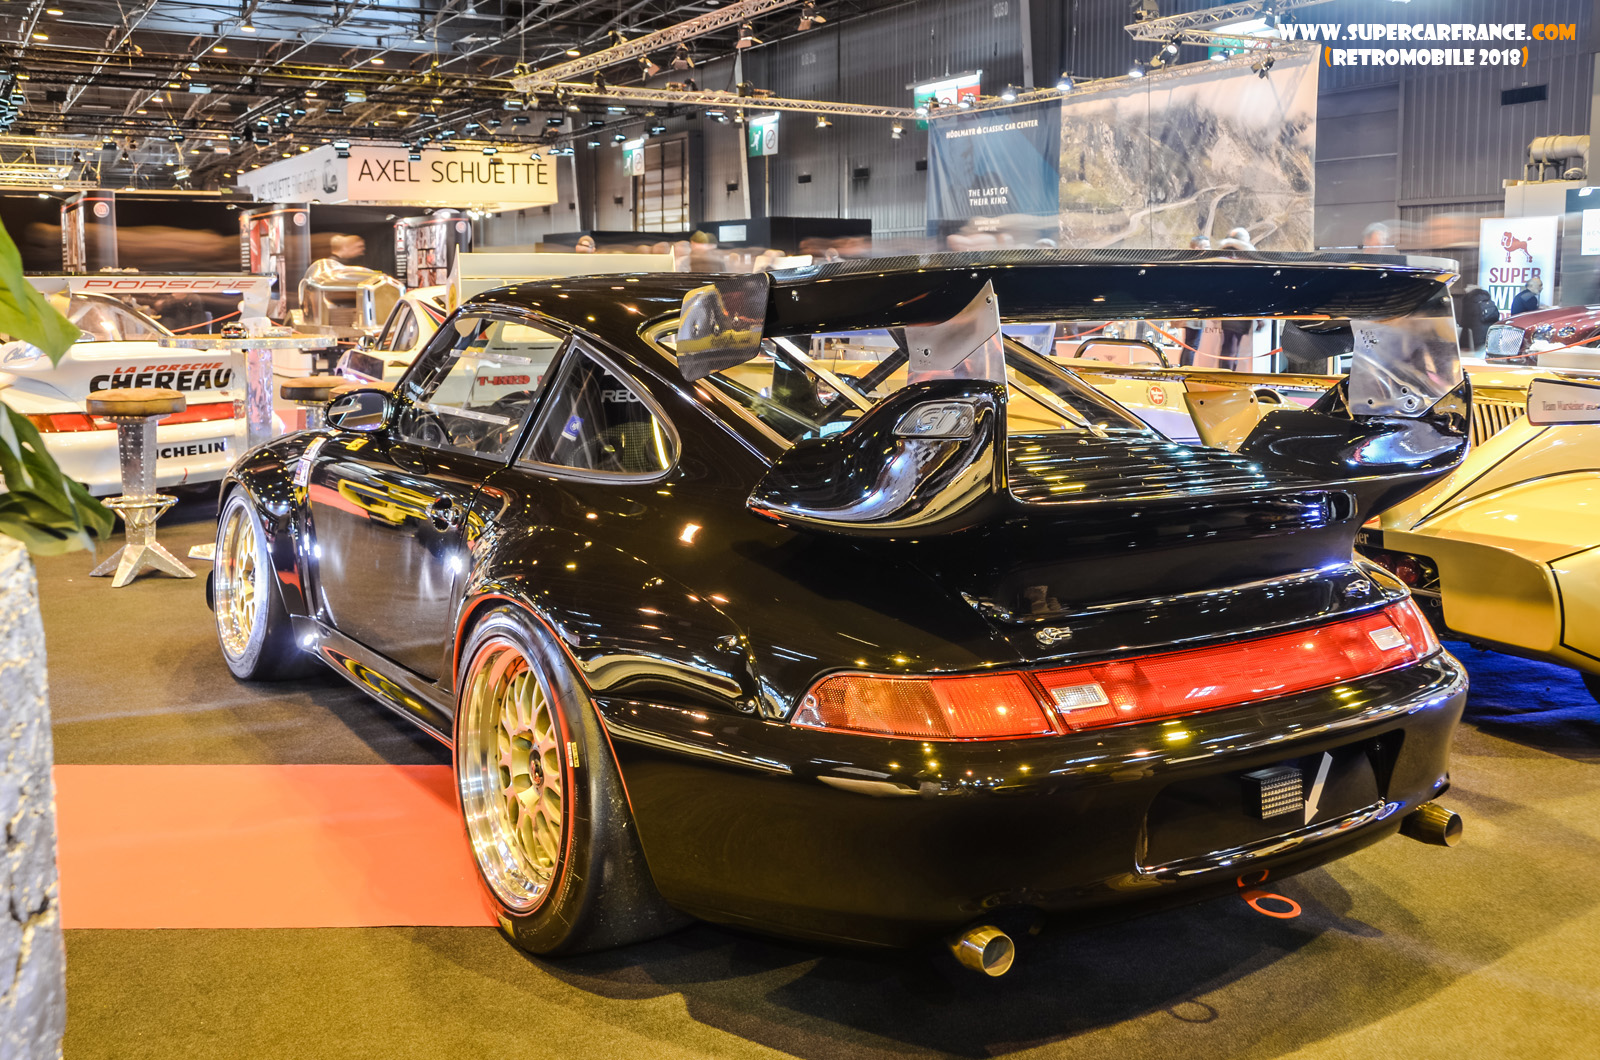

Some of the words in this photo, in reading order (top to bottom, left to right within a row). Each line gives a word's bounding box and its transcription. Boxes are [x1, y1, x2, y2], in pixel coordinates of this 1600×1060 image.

[982, 124, 1004, 134] CLASSIC
[1005, 122, 1016, 131] CAR
[1016, 119, 1039, 129] CENTER
[358, 158, 420, 182] AXEL
[431, 160, 548, 185] SCHUETTE
[968, 189, 981, 197] THE
[983, 187, 998, 196] LAST
[999, 186, 1009, 195] OF
[969, 198, 988, 206] THEIR
[990, 196, 1008, 205] KIND.
[1489, 267, 1541, 283] SUPER
[84, 280, 257, 289] PORSCHE
[113, 366, 137, 374] LA
[142, 362, 223, 373] PORSCHE
[156, 441, 226, 460] ICHELIN
